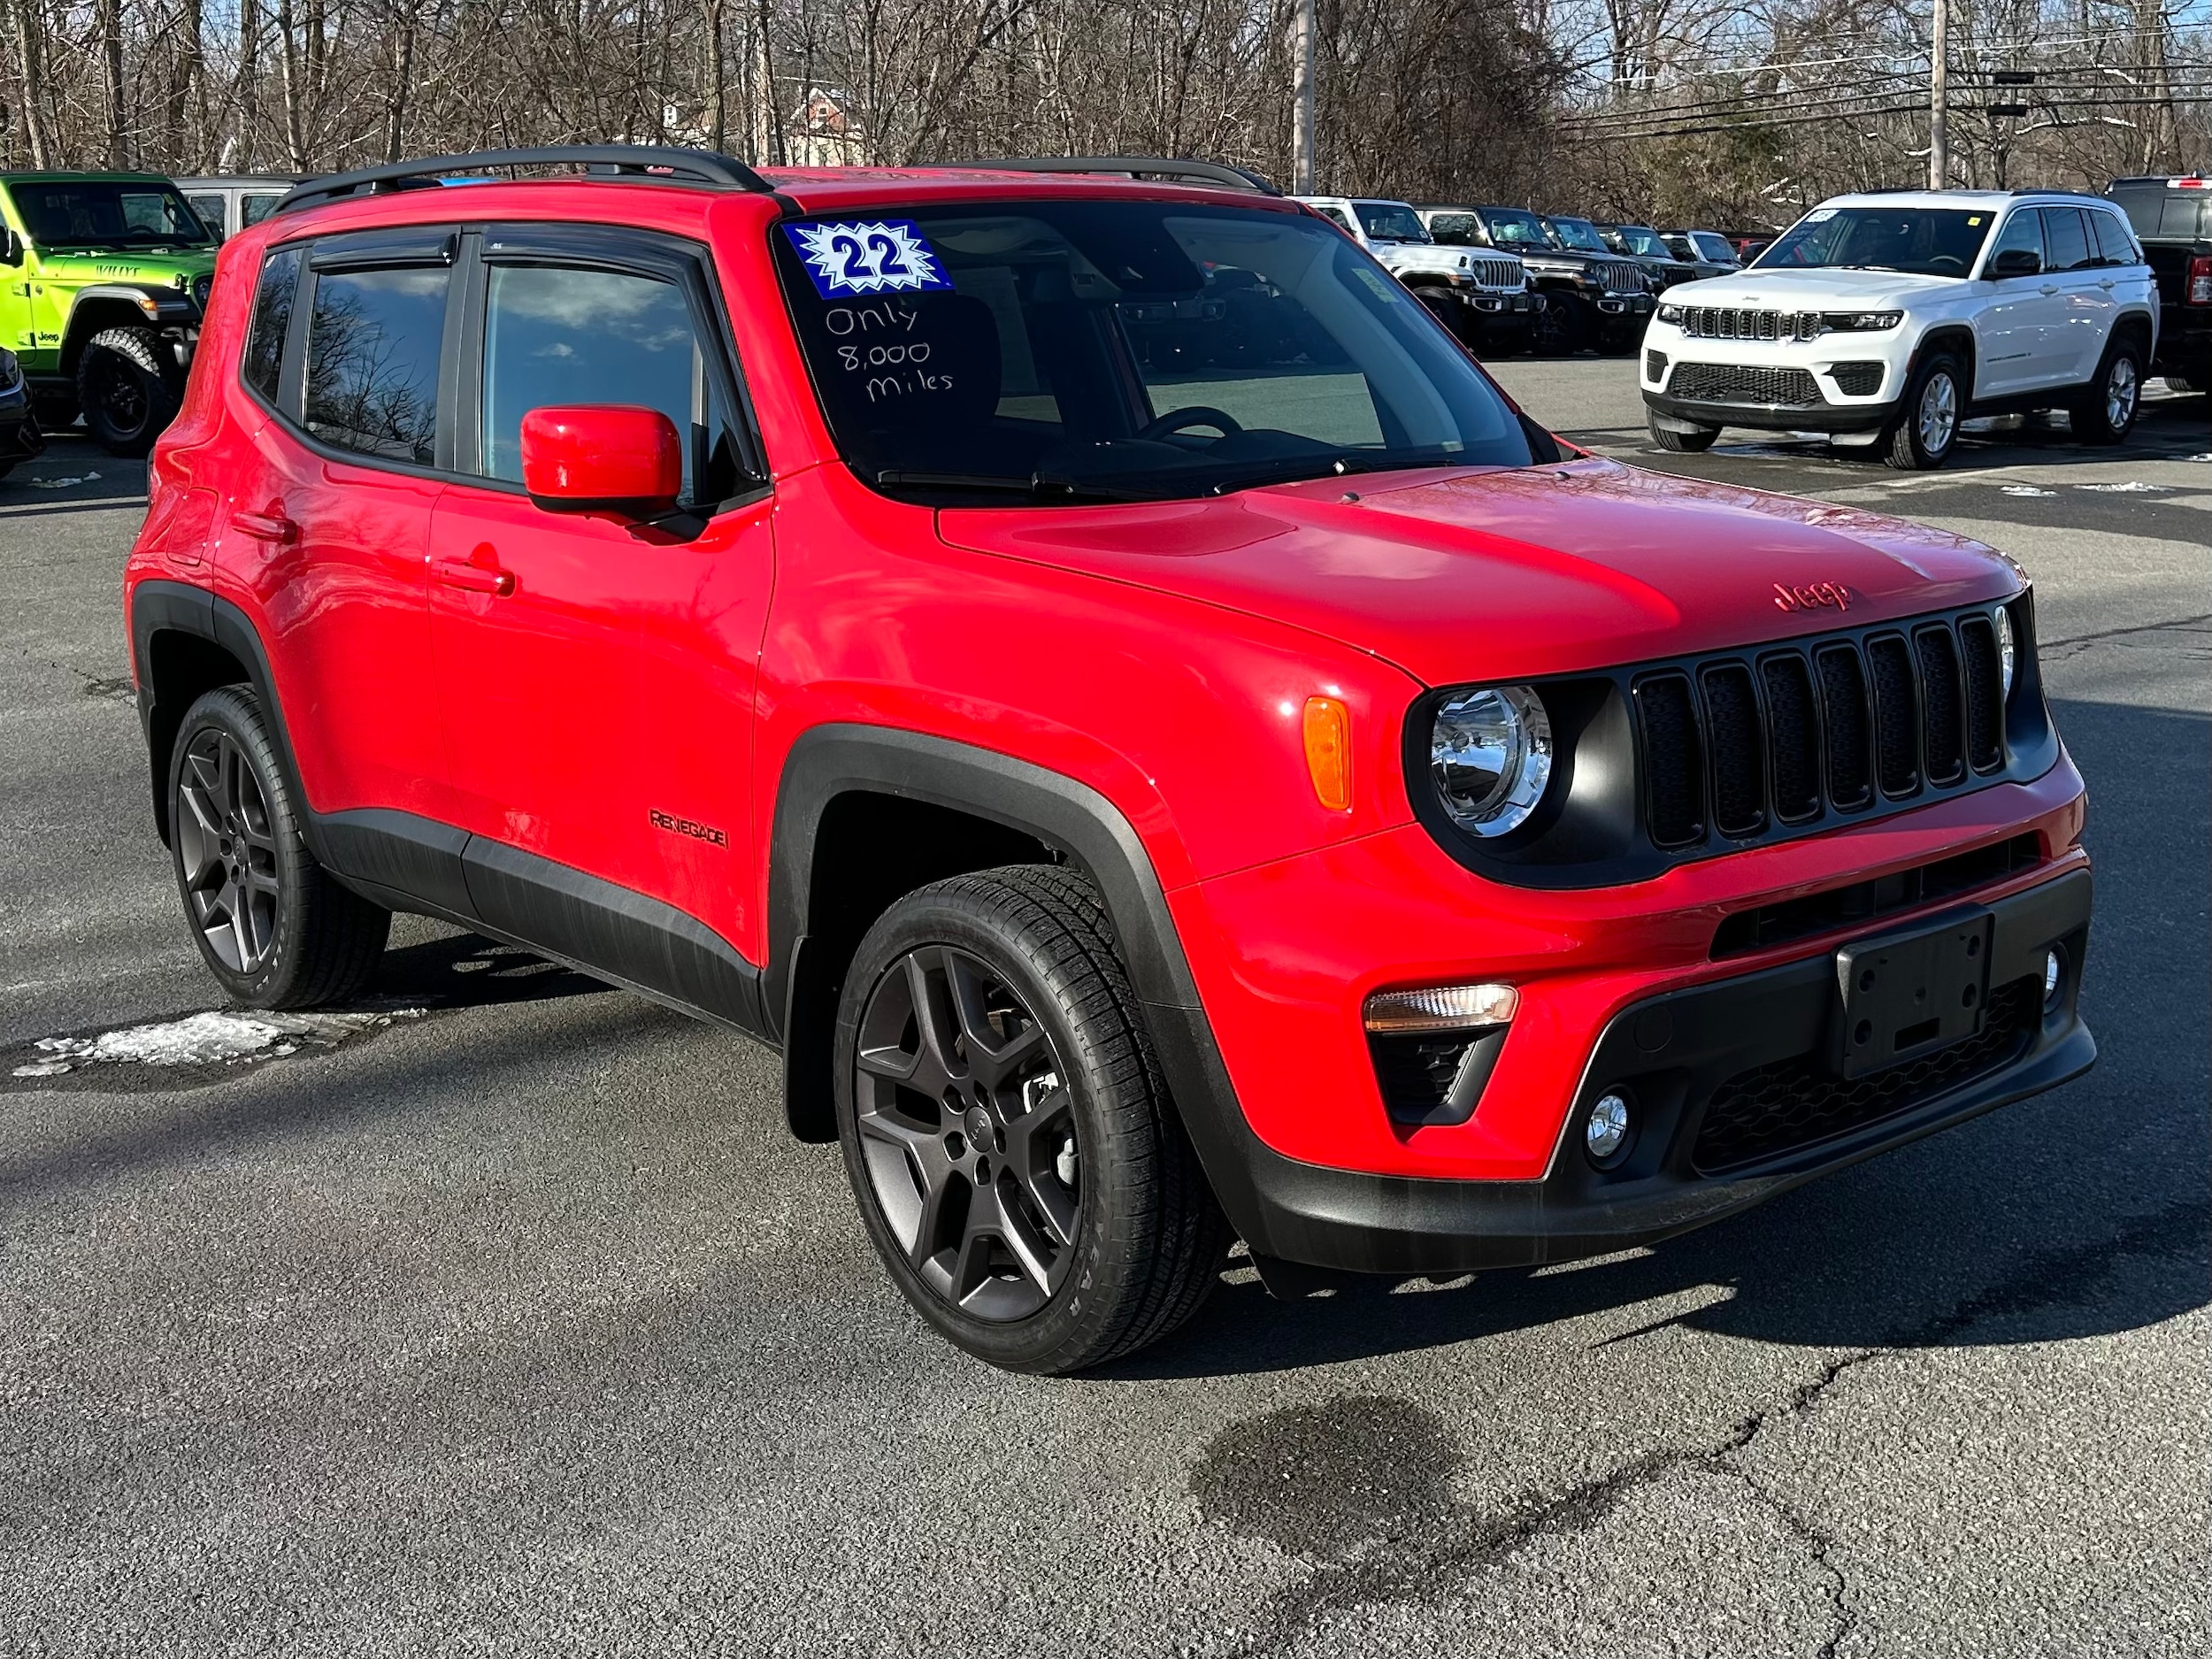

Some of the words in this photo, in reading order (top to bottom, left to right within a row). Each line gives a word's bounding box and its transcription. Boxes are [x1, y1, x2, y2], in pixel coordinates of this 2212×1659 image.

[832, 234, 912, 279] 22
[826, 302, 918, 335] Only
[38, 331, 59, 343] Jeep
[1773, 580, 1854, 612] Jeep
[649, 808, 728, 849] RENEGADE
